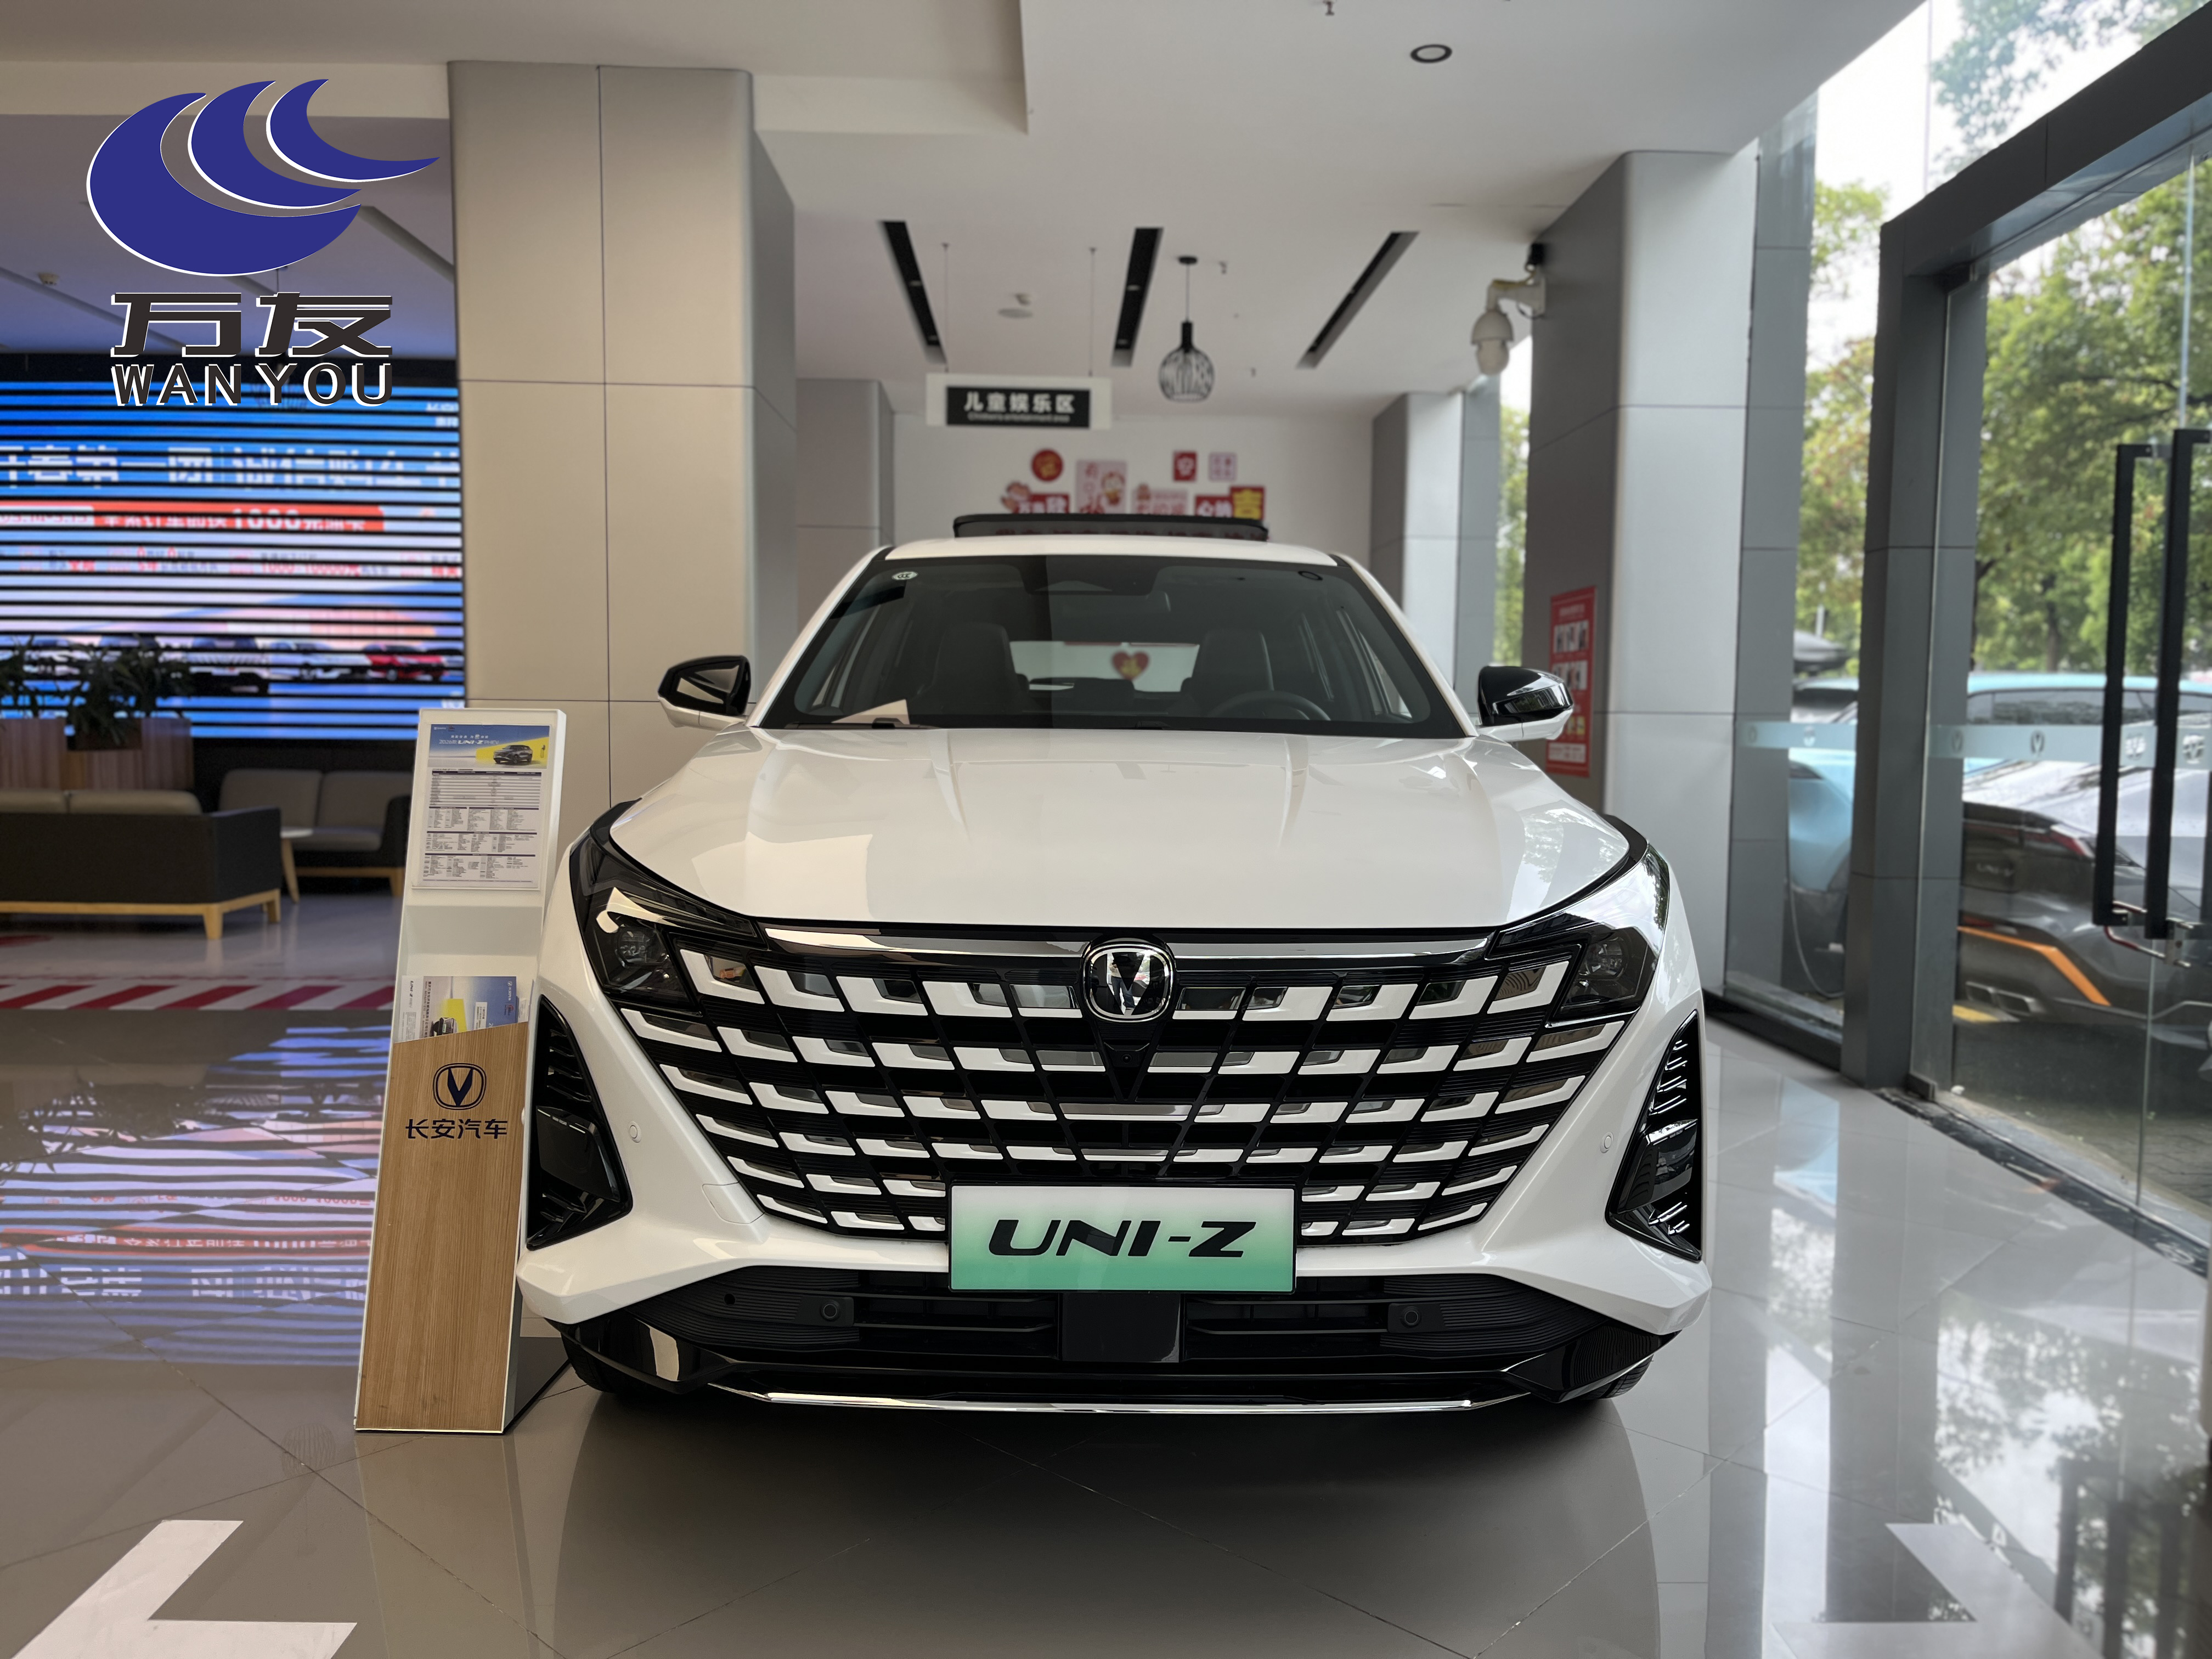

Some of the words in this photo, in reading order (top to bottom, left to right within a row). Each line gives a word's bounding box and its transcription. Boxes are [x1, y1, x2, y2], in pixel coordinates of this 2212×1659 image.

[964, 391, 1075, 413] 儿童娱乐区
[405, 1119, 507, 1139] 长安汽车
[989, 1219, 1256, 1257] UNI-Z
